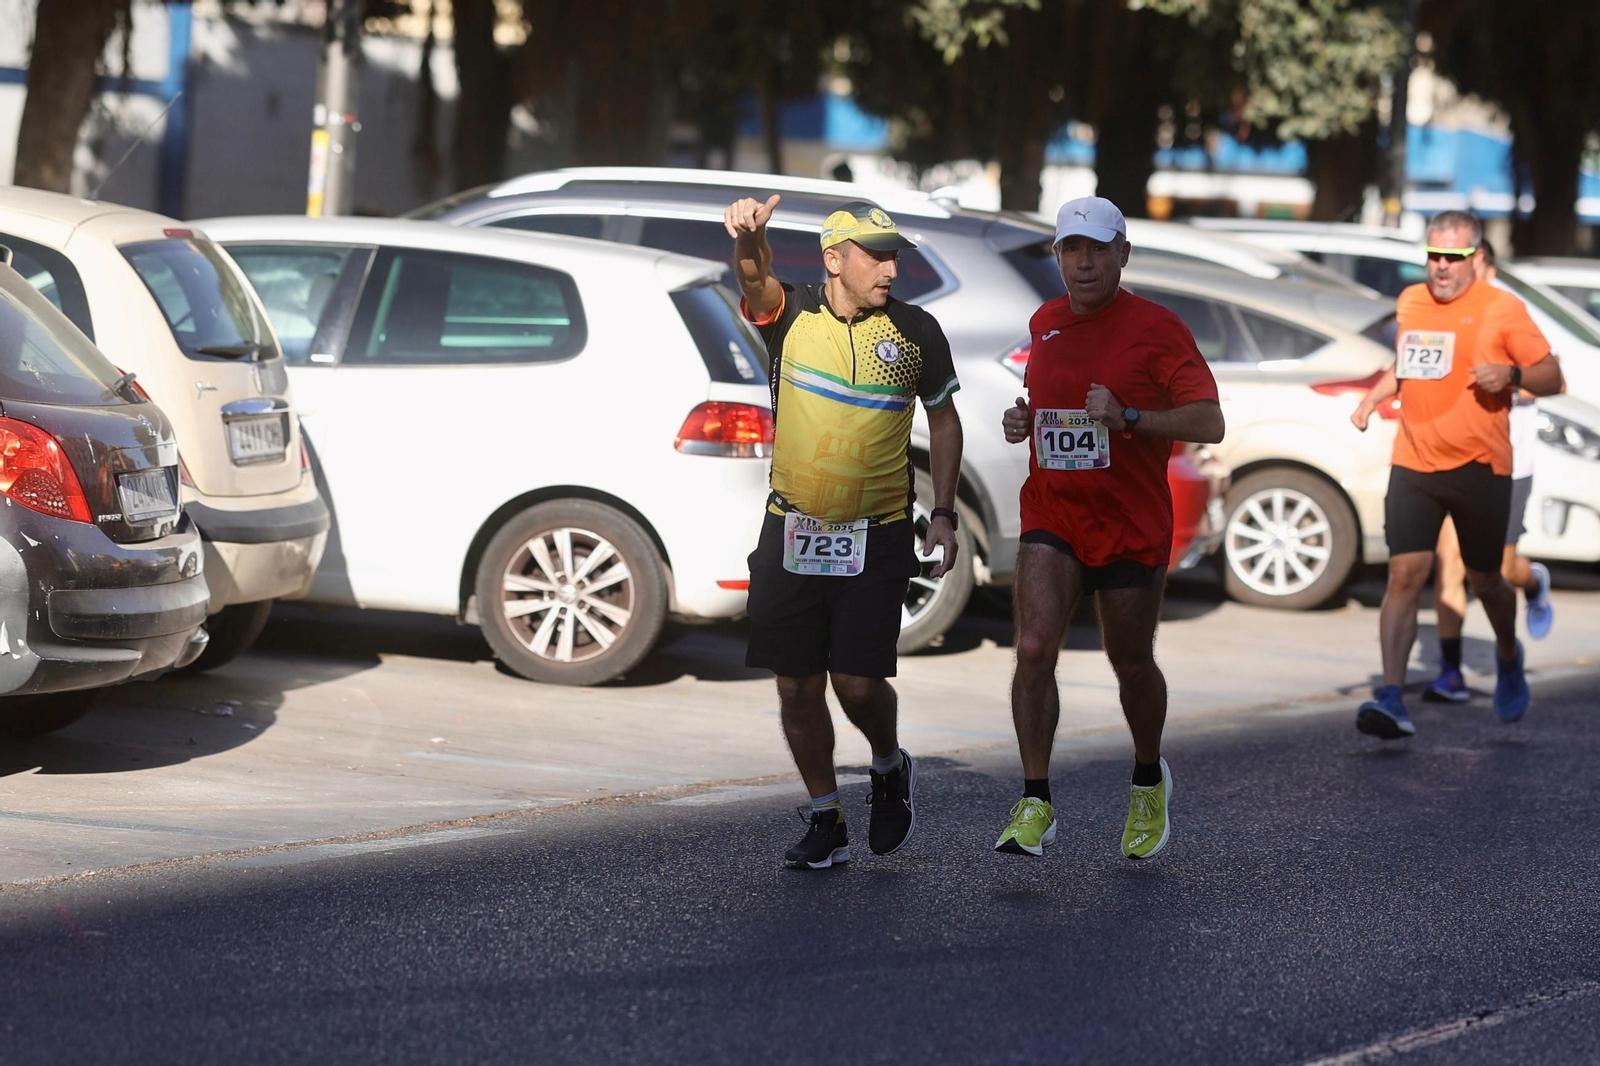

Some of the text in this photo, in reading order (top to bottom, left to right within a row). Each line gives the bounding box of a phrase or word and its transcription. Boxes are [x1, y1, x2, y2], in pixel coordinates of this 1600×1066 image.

[1407, 348, 1442, 364] 727
[1043, 431, 1096, 452] 104
[827, 524, 854, 532] 2025
[796, 535, 853, 557] 723
[1128, 833, 1150, 848] CRA
